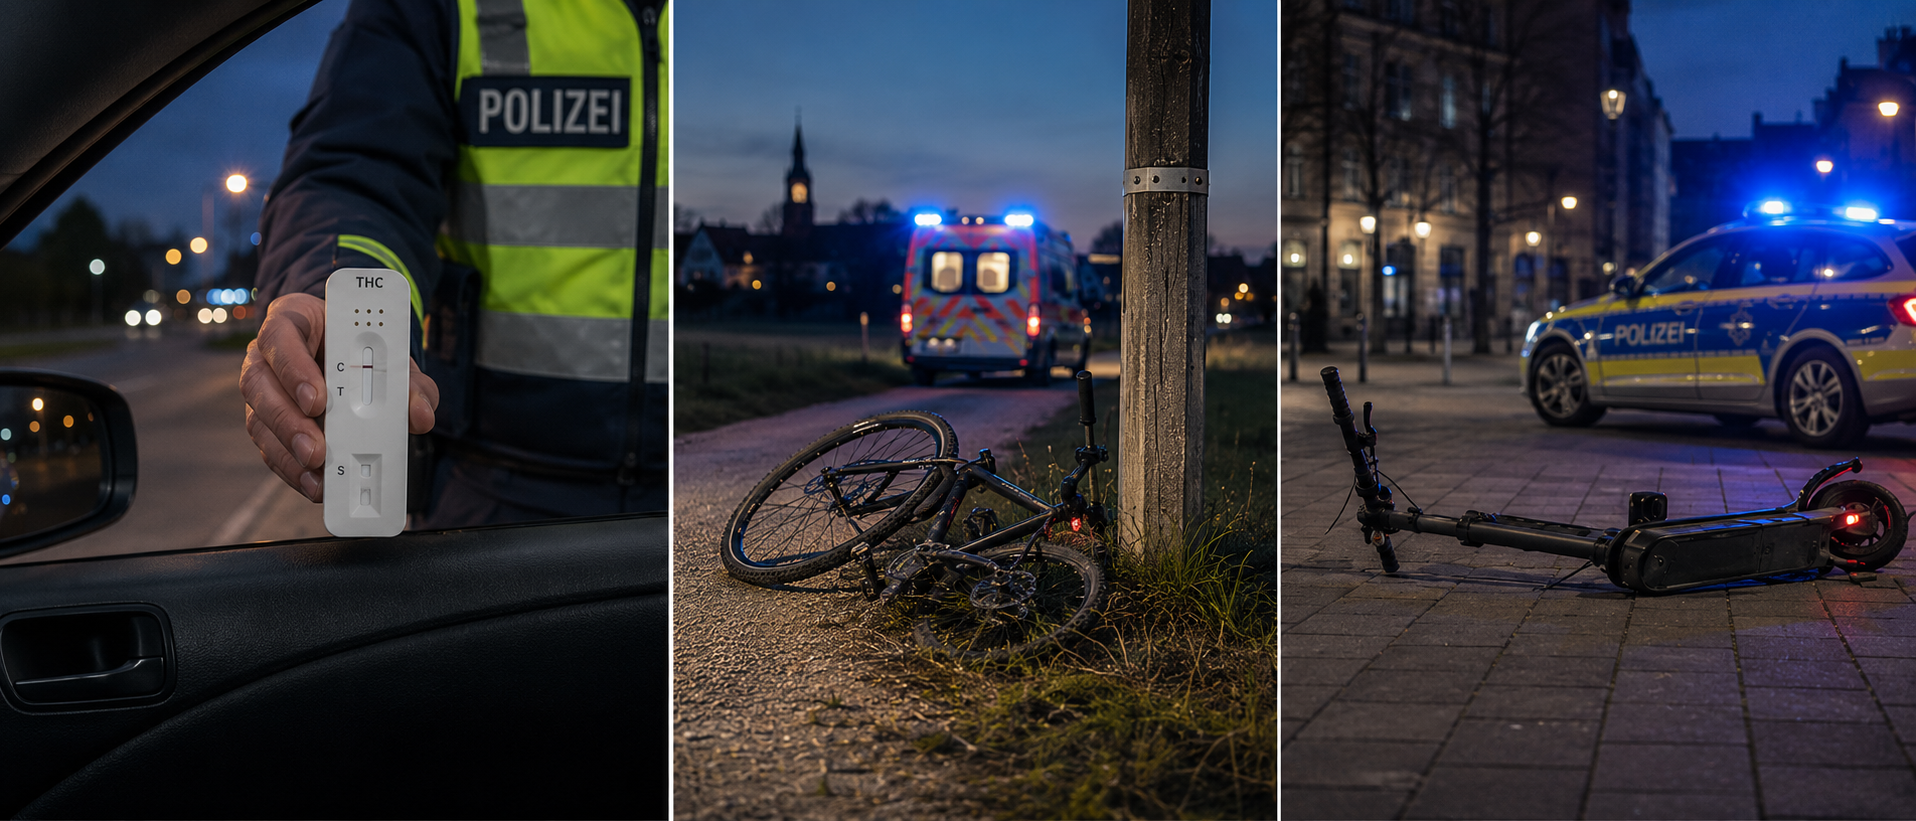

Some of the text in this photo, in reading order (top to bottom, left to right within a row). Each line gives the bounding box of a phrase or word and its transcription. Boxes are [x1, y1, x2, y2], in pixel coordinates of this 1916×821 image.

[478, 87, 622, 134] POLIZEI
[356, 276, 384, 289] THC
[1614, 321, 1686, 346] POLIZEI
[336, 361, 345, 372] C
[336, 386, 345, 397] T
[337, 465, 345, 476] S
